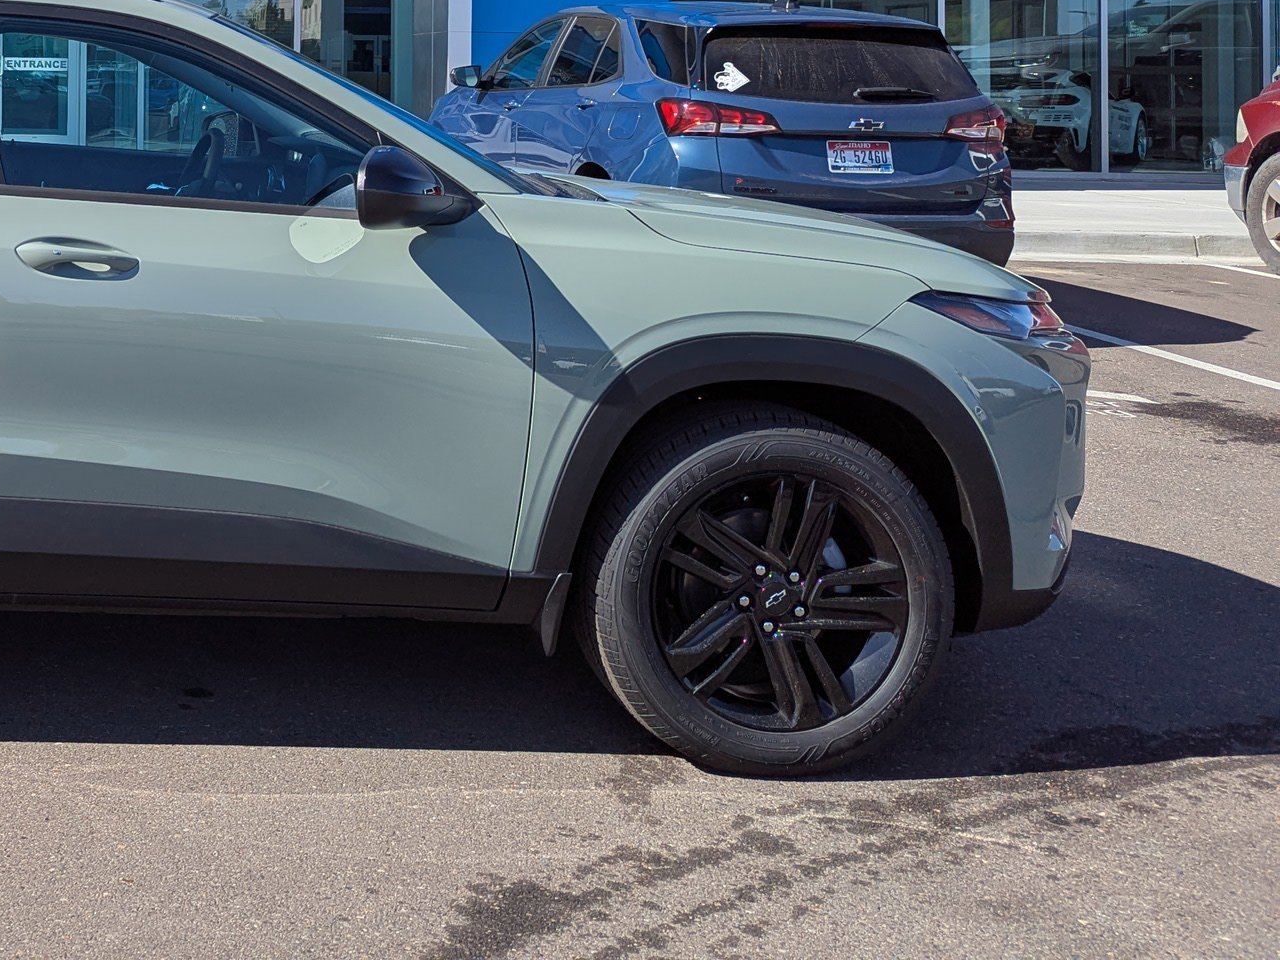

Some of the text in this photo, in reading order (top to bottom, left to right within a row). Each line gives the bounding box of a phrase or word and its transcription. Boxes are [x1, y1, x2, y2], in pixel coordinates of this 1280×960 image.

[6, 60, 68, 69] ENTRANCE
[832, 150, 847, 163] 2G
[624, 462, 709, 582] GOODYEAR
